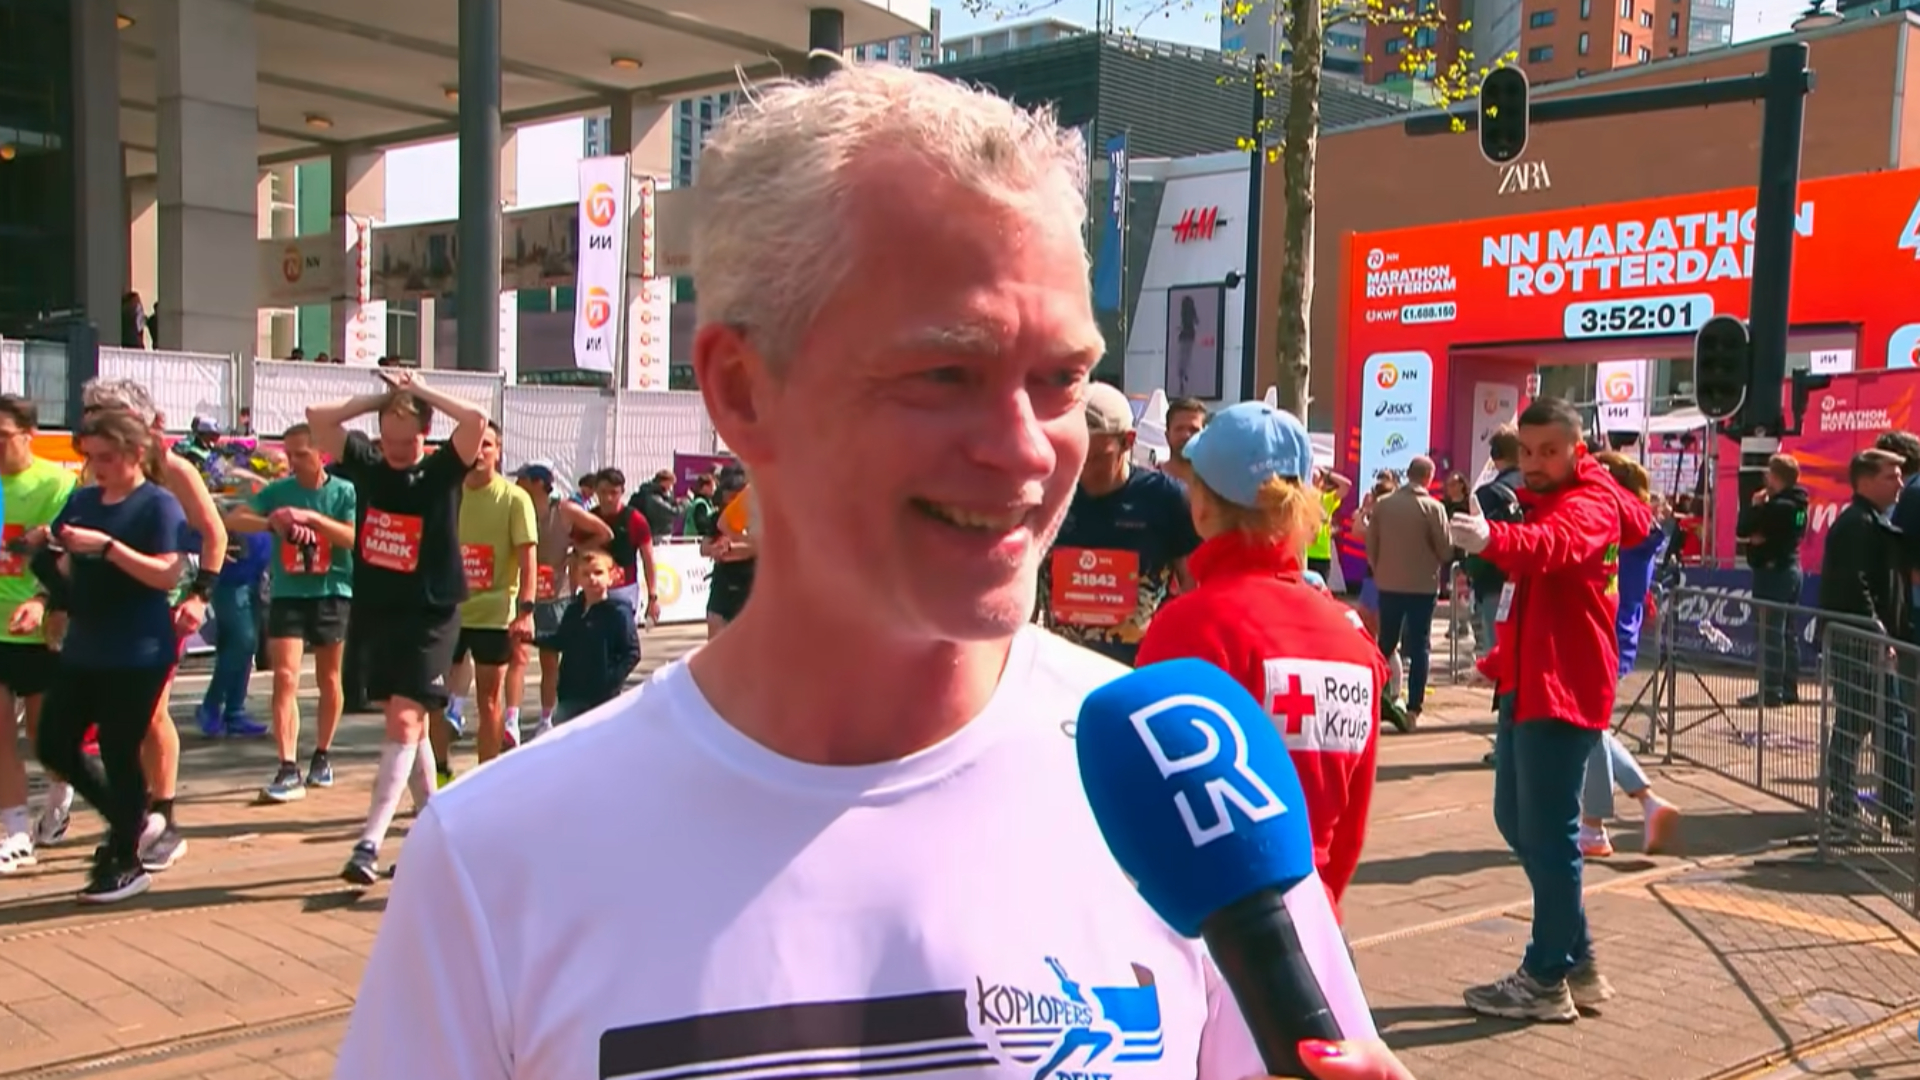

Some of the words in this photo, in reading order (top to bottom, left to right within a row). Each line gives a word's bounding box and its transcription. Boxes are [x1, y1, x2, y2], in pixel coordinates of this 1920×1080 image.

[1498, 160, 1551, 195] ZARA
[305, 256, 320, 268] NN
[1482, 231, 1539, 267] NN
[1366, 264, 1450, 285] MARATHON
[1508, 245, 1753, 297] ROTTERDA
[1366, 277, 1457, 298] ROTTERDAM
[1580, 302, 1693, 332] 3:52:01
[1401, 369, 1418, 380] NN
[1821, 408, 1887, 421] MARATHON
[1821, 418, 1892, 432] ROTTERDAM
[365, 536, 413, 560] MARK
[1324, 676, 1369, 706] Rode
[1324, 709, 1368, 741] Kruis
[976, 974, 1093, 1027] KOPLOPERS
